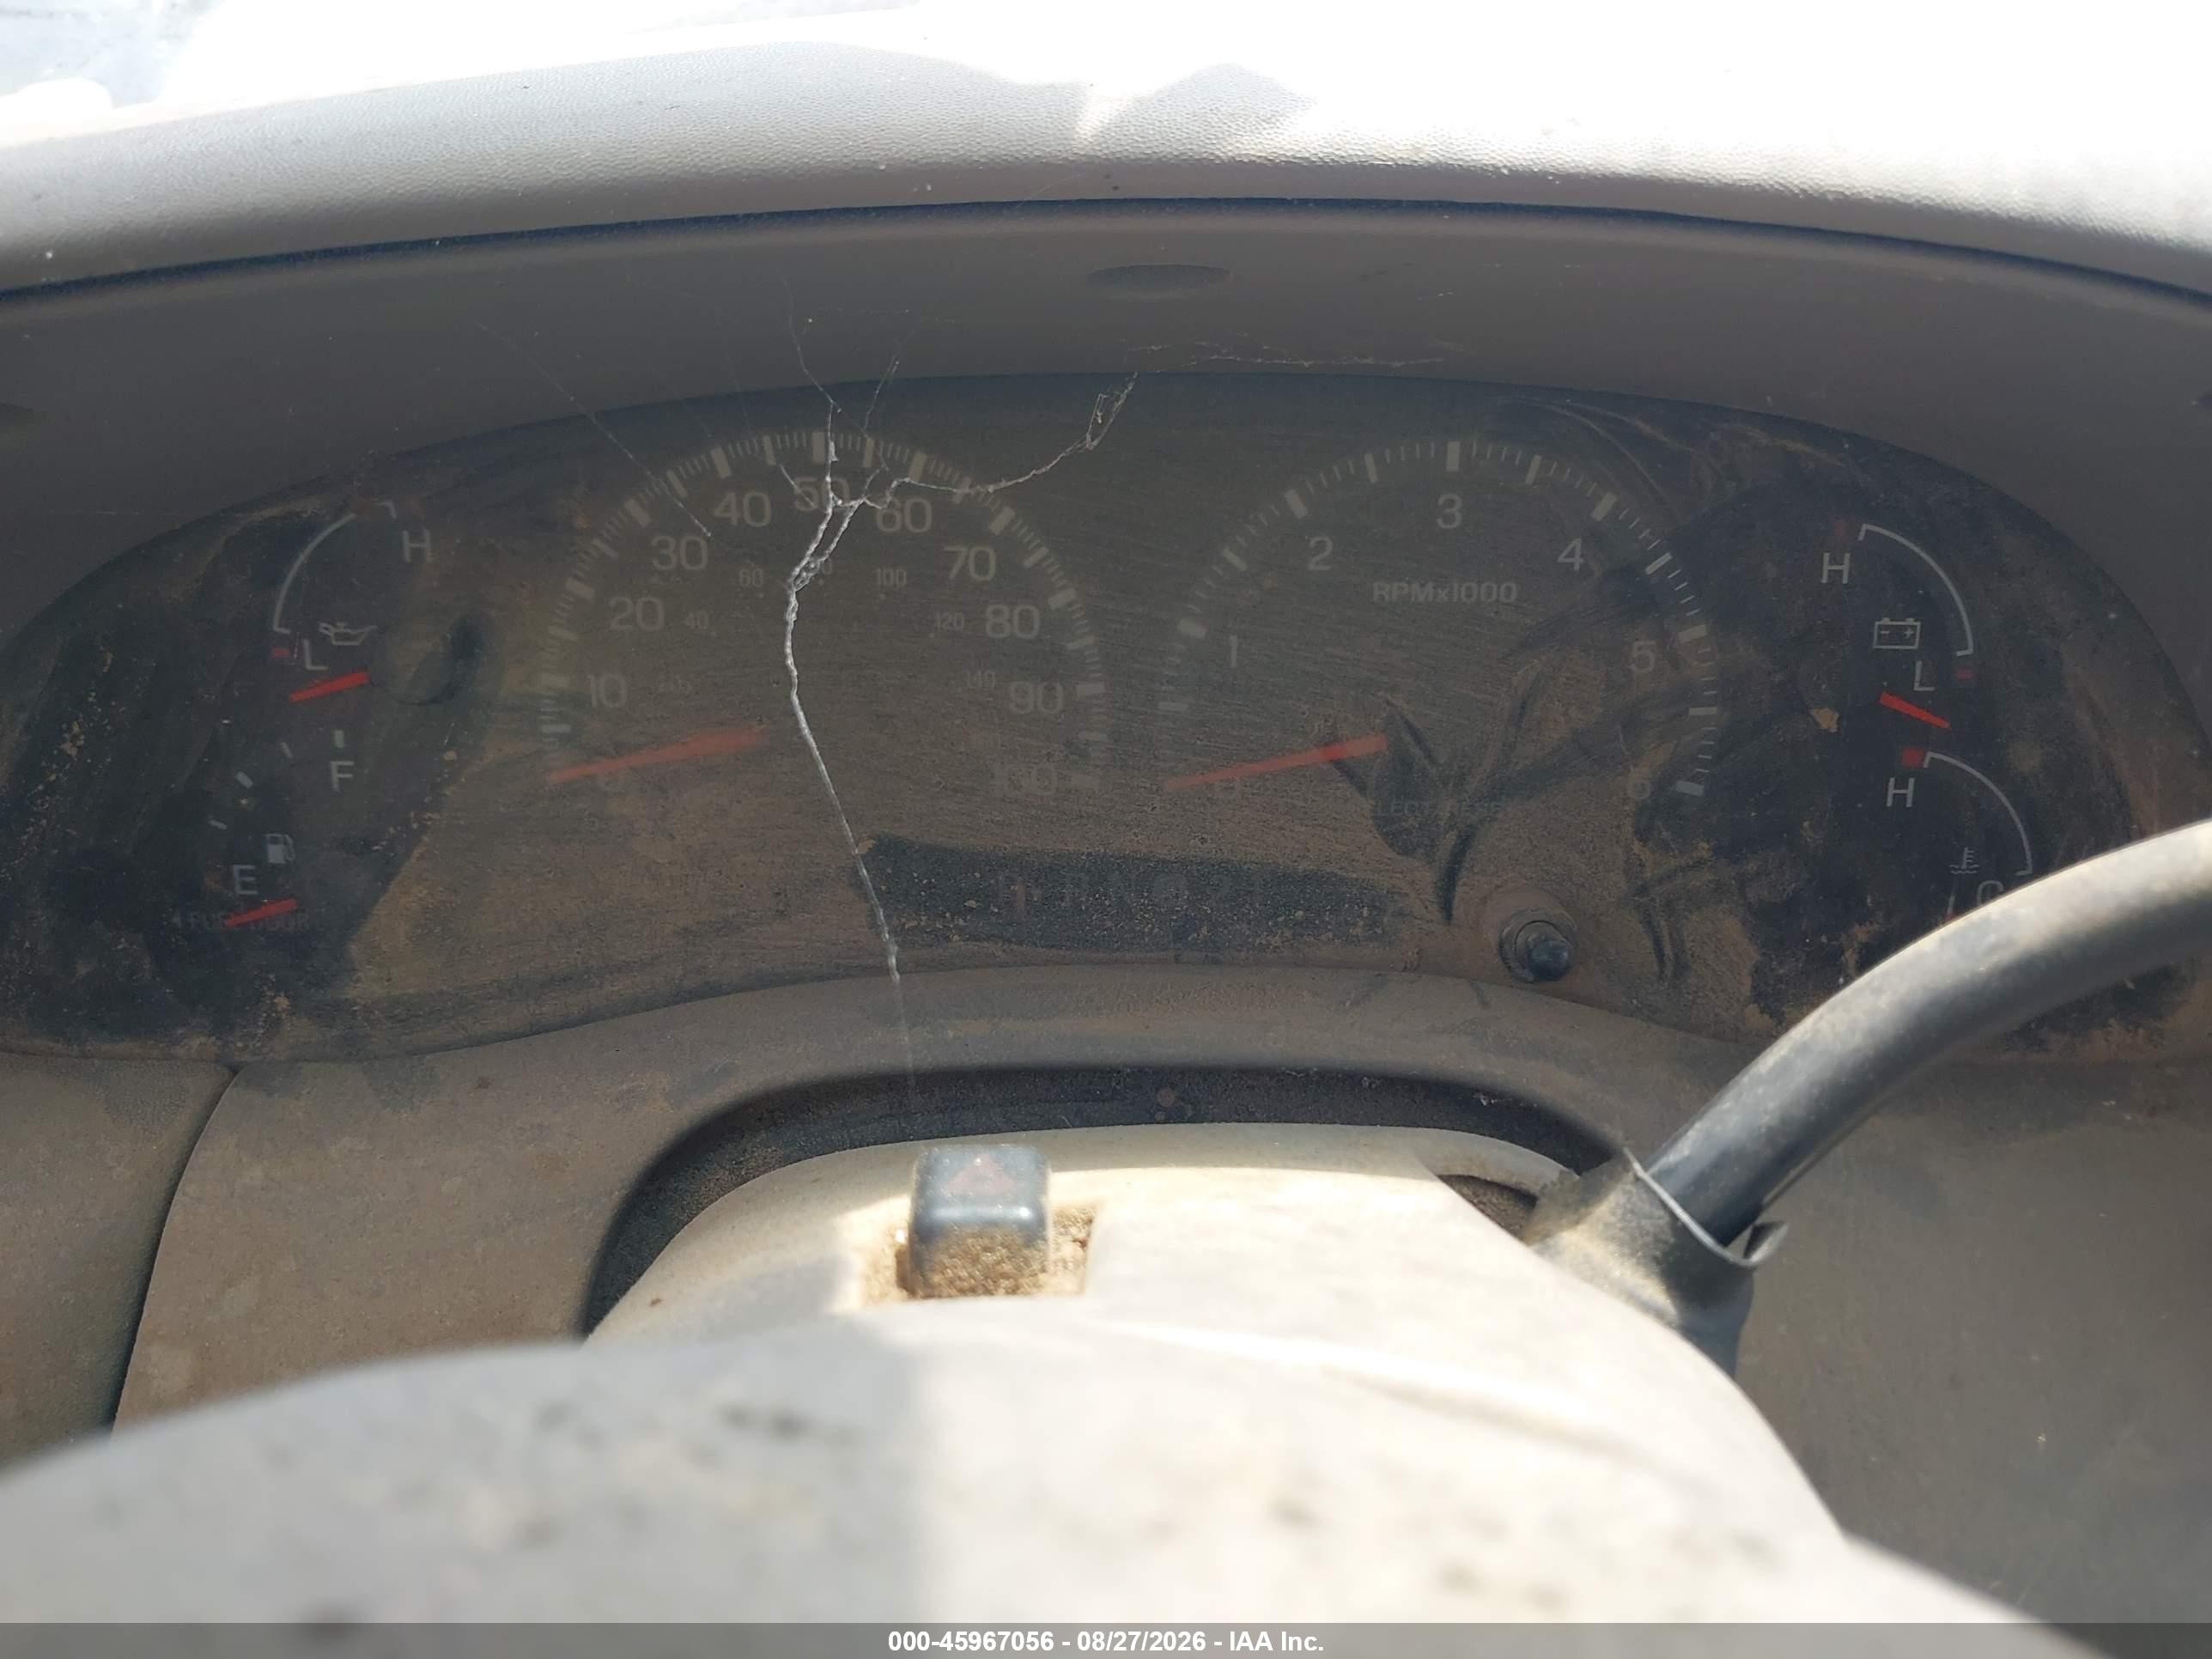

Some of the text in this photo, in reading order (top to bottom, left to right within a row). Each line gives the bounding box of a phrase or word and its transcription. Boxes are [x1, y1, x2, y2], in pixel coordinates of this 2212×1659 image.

[714, 492, 771, 527] 40
[793, 477, 850, 512] 50
[877, 495, 933, 532] 60
[1436, 494, 1462, 530] 3
[403, 529, 429, 562] H
[652, 534, 708, 571] 30
[1309, 537, 1333, 571] 2
[1558, 538, 1585, 571] 4
[738, 567, 763, 587] 60
[876, 568, 907, 587] 100
[946, 545, 996, 581] 70
[1820, 553, 1850, 584] H
[608, 596, 665, 632] 20
[685, 612, 708, 630] 40
[934, 612, 965, 630] 120
[985, 605, 1040, 640] 80
[304, 639, 328, 670] L
[1227, 634, 1238, 668] 1
[1631, 639, 1656, 673] 5
[587, 672, 628, 708] 10
[1913, 660, 1936, 690] L
[1009, 680, 1064, 716] 90
[330, 761, 354, 791] F
[1886, 777, 1915, 807] H
[232, 865, 258, 896] E
